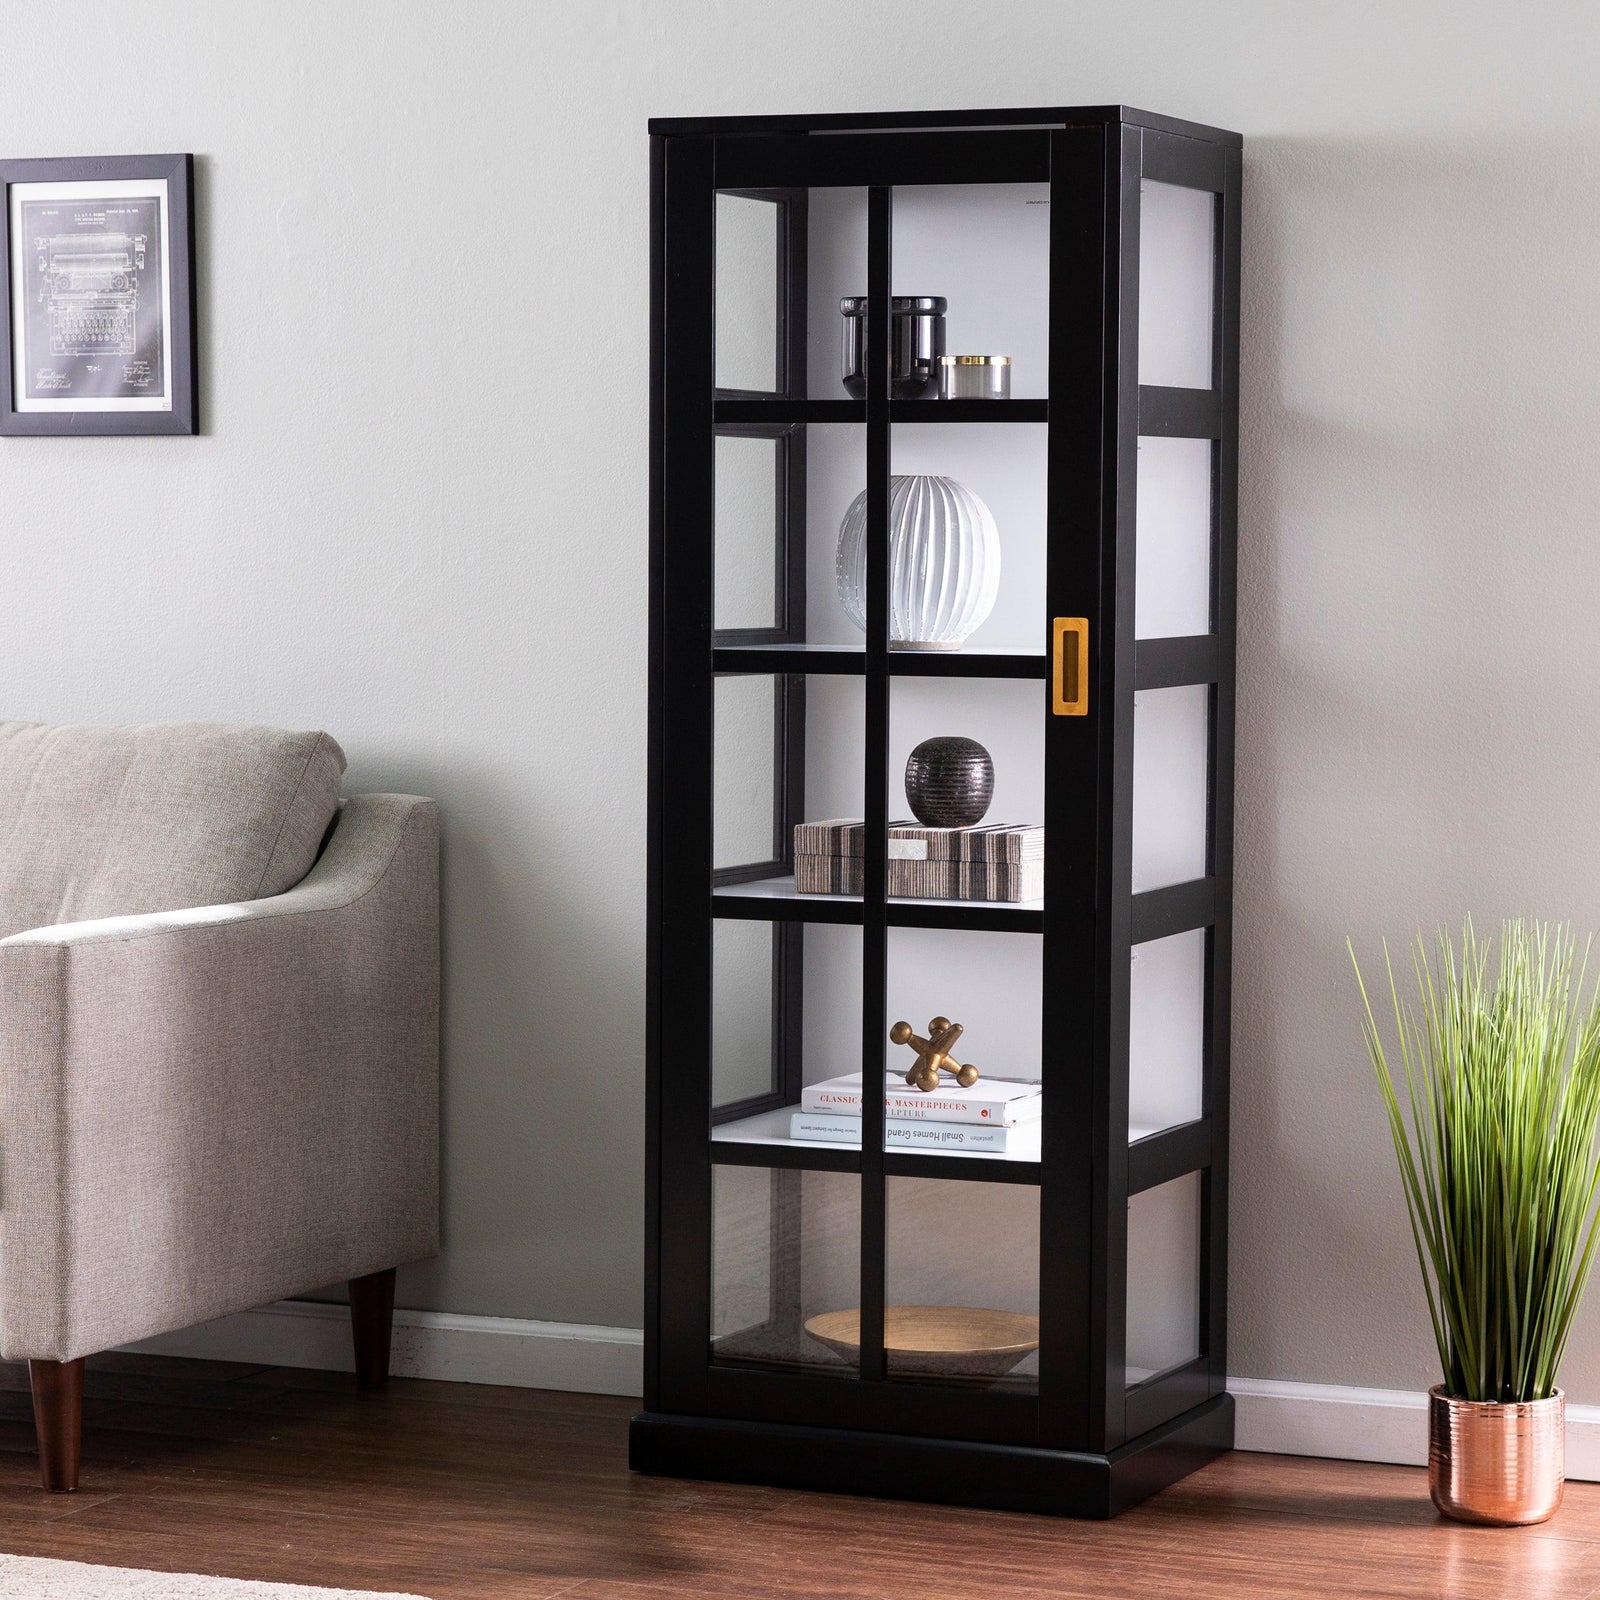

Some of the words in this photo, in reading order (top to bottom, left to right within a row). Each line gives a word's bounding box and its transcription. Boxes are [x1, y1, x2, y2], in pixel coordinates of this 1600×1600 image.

[820, 1095, 857, 1104] CLASSIC
[895, 1099, 968, 1111] MASTERPIECES
[887, 1129, 911, 1140] Grand
[913, 1130, 940, 1141] Homes
[941, 1132, 965, 1143] Small
